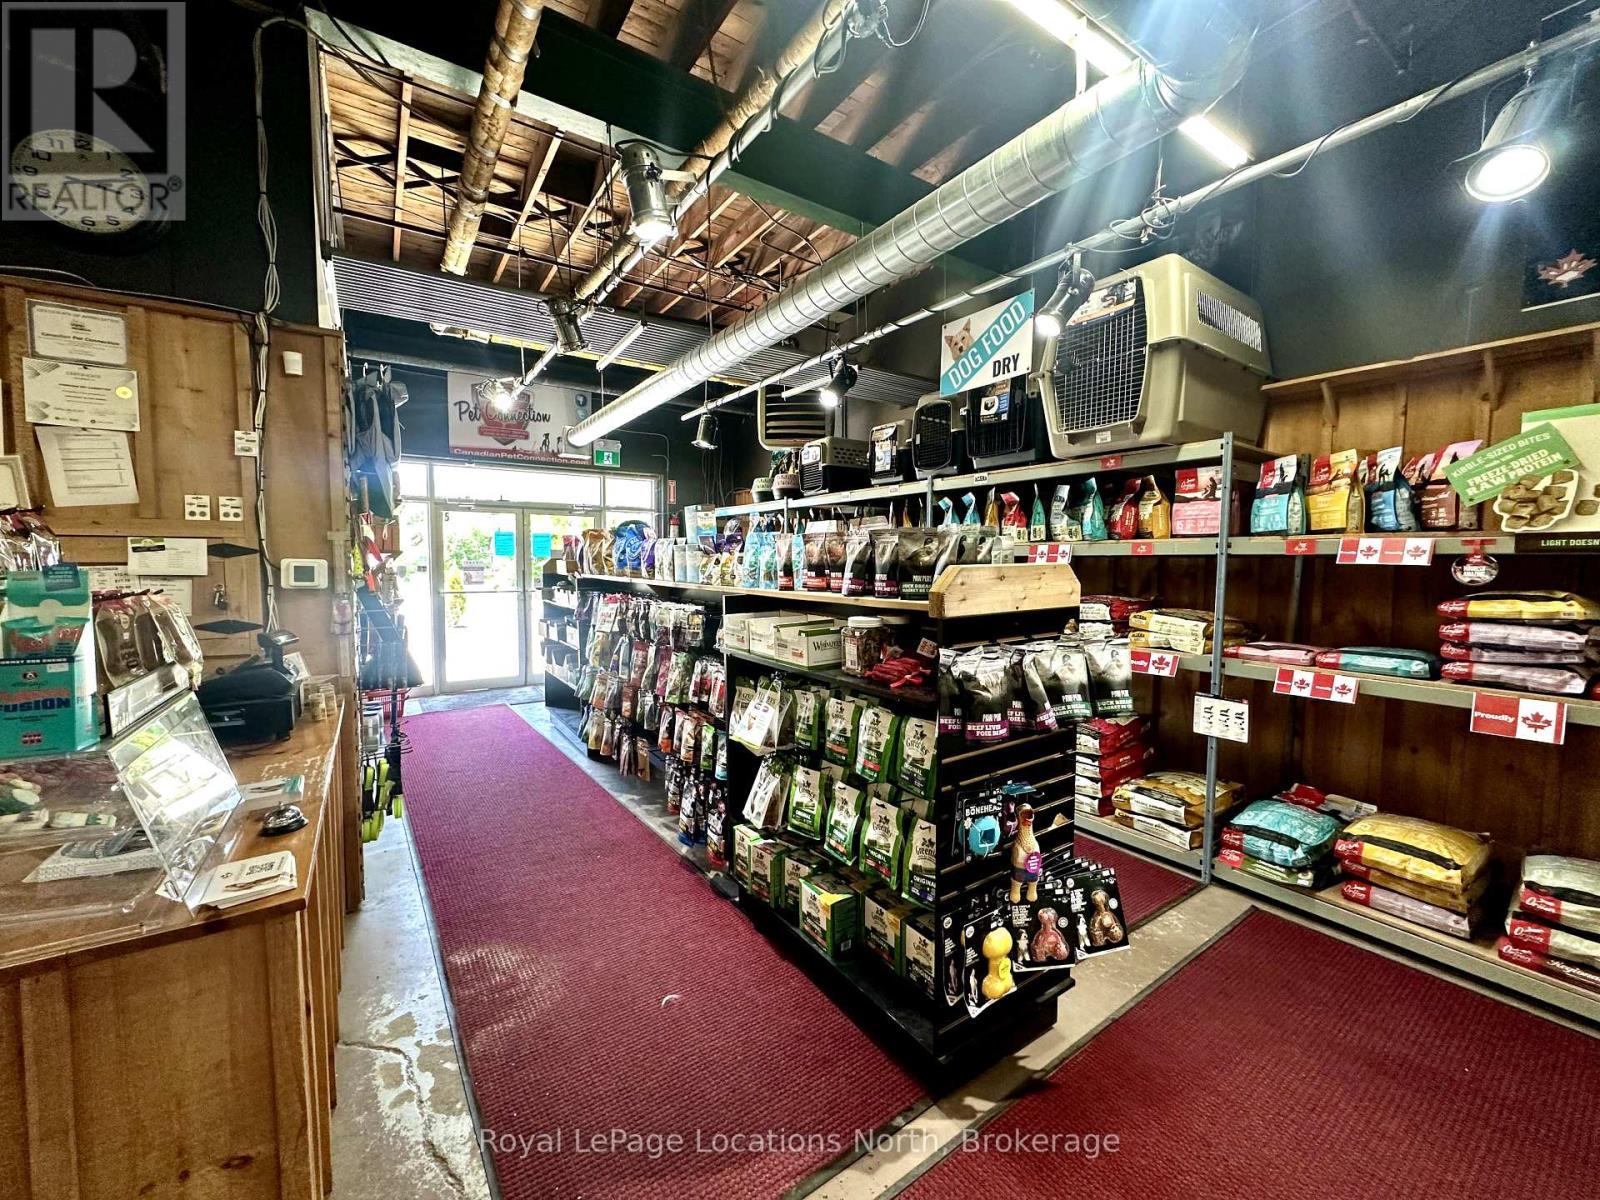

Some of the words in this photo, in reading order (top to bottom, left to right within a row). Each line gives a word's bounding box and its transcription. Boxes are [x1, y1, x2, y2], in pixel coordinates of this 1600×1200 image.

[948, 347, 983, 389] DOG
[981, 300, 1026, 356] FOOD
[992, 352, 1020, 378] DRY
[453, 400, 481, 422] Pet
[485, 400, 552, 423] Connection
[453, 448, 590, 466] CanadianPetConnection.com
[1452, 443, 1517, 478] KIBBLE-SIZED
[1517, 432, 1552, 448] BITES
[1465, 475, 1507, 496] RAW
[1508, 452, 1564, 480] PROTEIN
[1467, 449, 1549, 487] FREEZE-DRIED
[1474, 710, 1515, 723] Proudly
[916, 845, 936, 856] Greeni
[913, 875, 936, 888] ORIGINA
